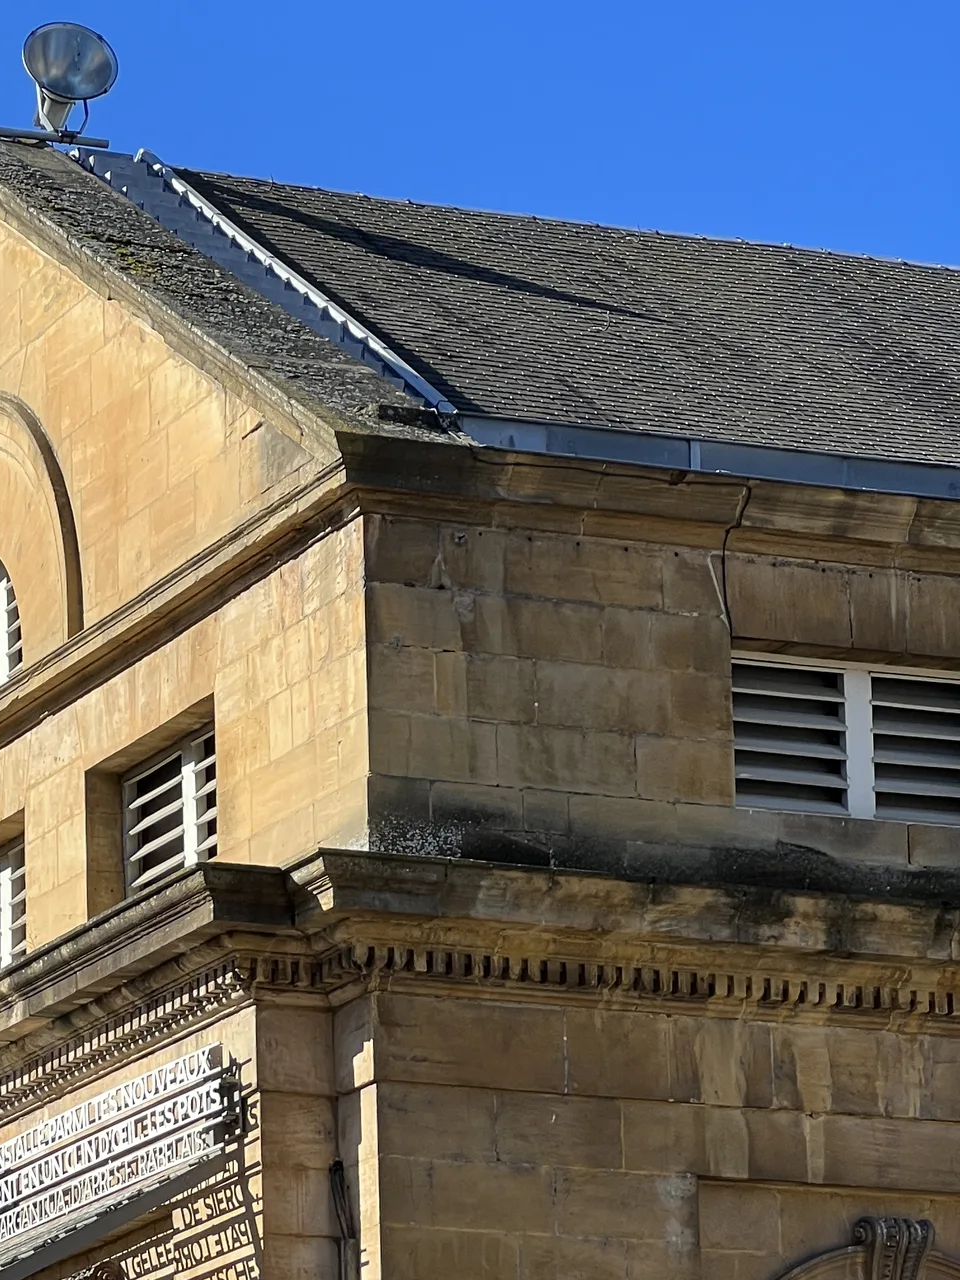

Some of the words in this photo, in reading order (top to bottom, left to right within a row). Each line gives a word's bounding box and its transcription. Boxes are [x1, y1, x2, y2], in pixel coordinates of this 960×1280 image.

[22, 1163, 38, 1194] EN
[43, 1152, 61, 1185] UN
[180, 1078, 220, 1123] POTS
[49, 1104, 87, 1145] PARMI
[98, 1090, 117, 1123] LES
[122, 1045, 211, 1111] NOUVEAUX
